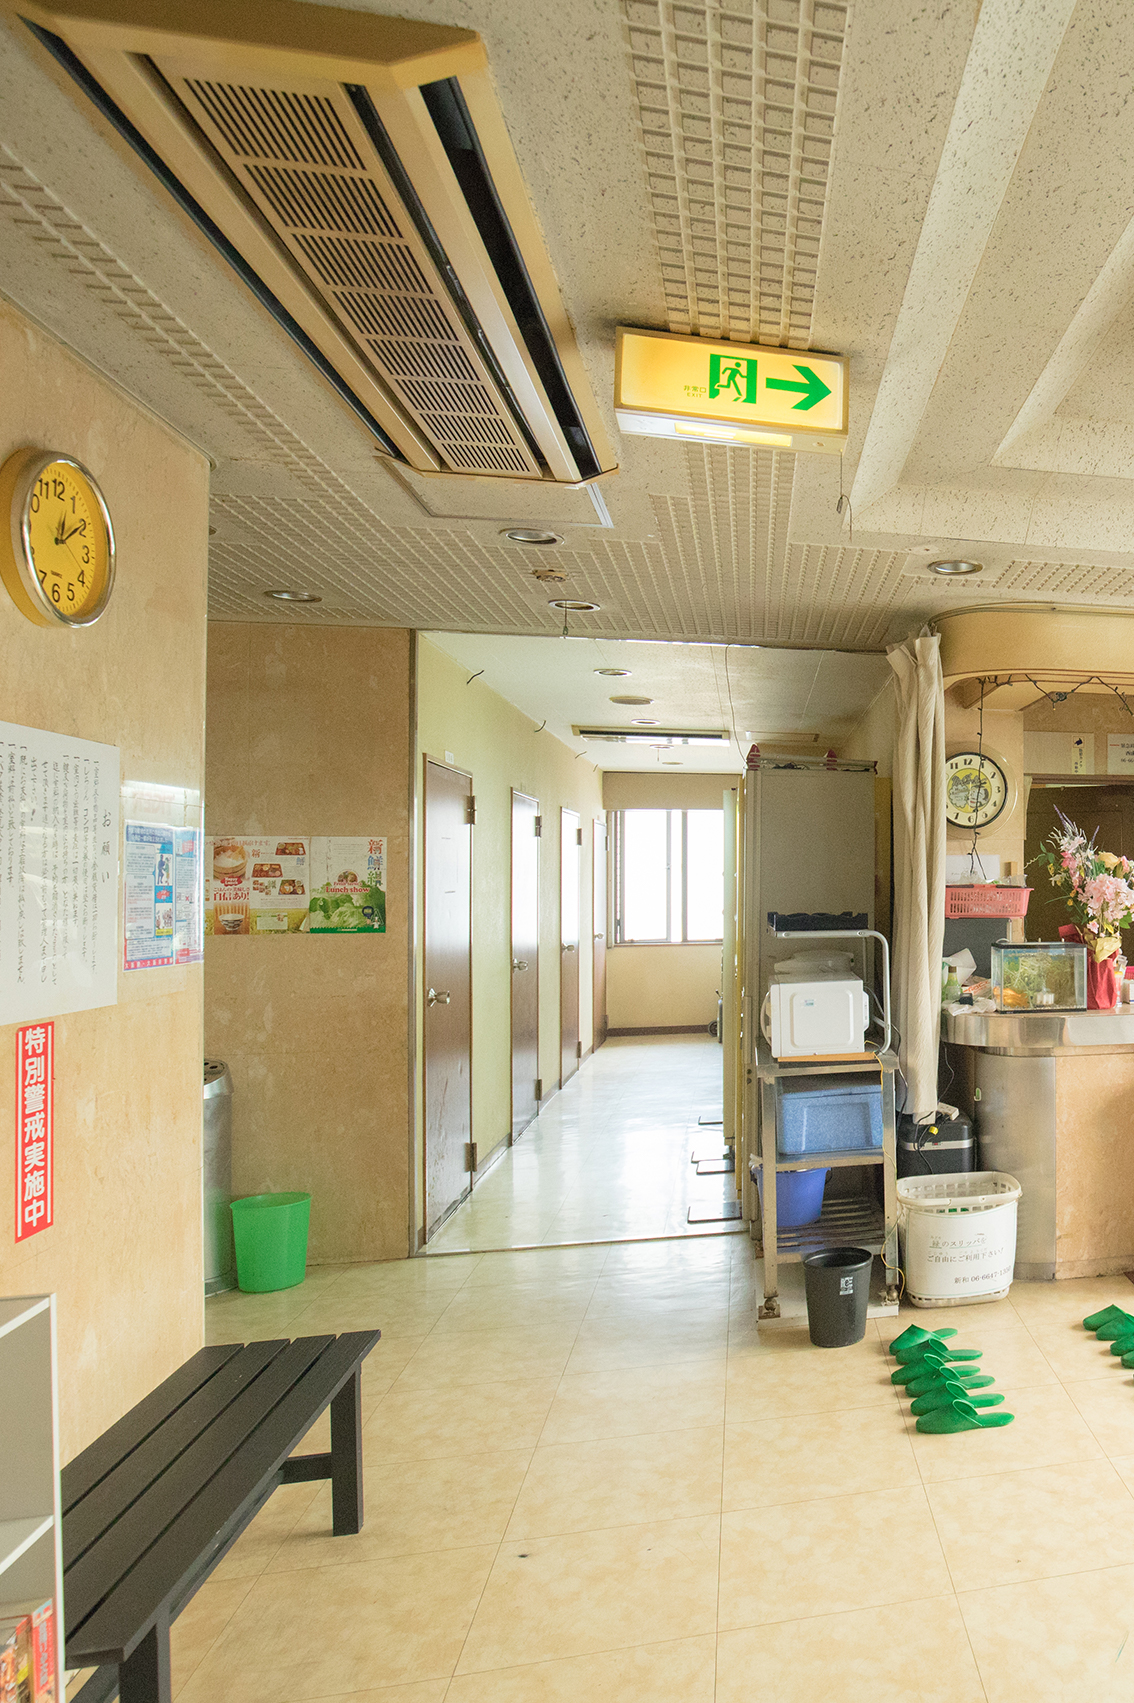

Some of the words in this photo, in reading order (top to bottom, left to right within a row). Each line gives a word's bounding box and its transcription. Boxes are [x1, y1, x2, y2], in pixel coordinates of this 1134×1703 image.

[684, 385, 706, 393] 非常口
[38, 478, 49, 499] 11
[52, 478, 66, 501] 12
[71, 496, 76, 514] 1
[79, 518, 86, 538] 2
[82, 545, 90, 564] 3
[78, 570, 85, 587] 4
[52, 583, 60, 602] 6
[66, 582, 74, 602] 5
[24, 1026, 46, 1227] 特別警戒実施中
